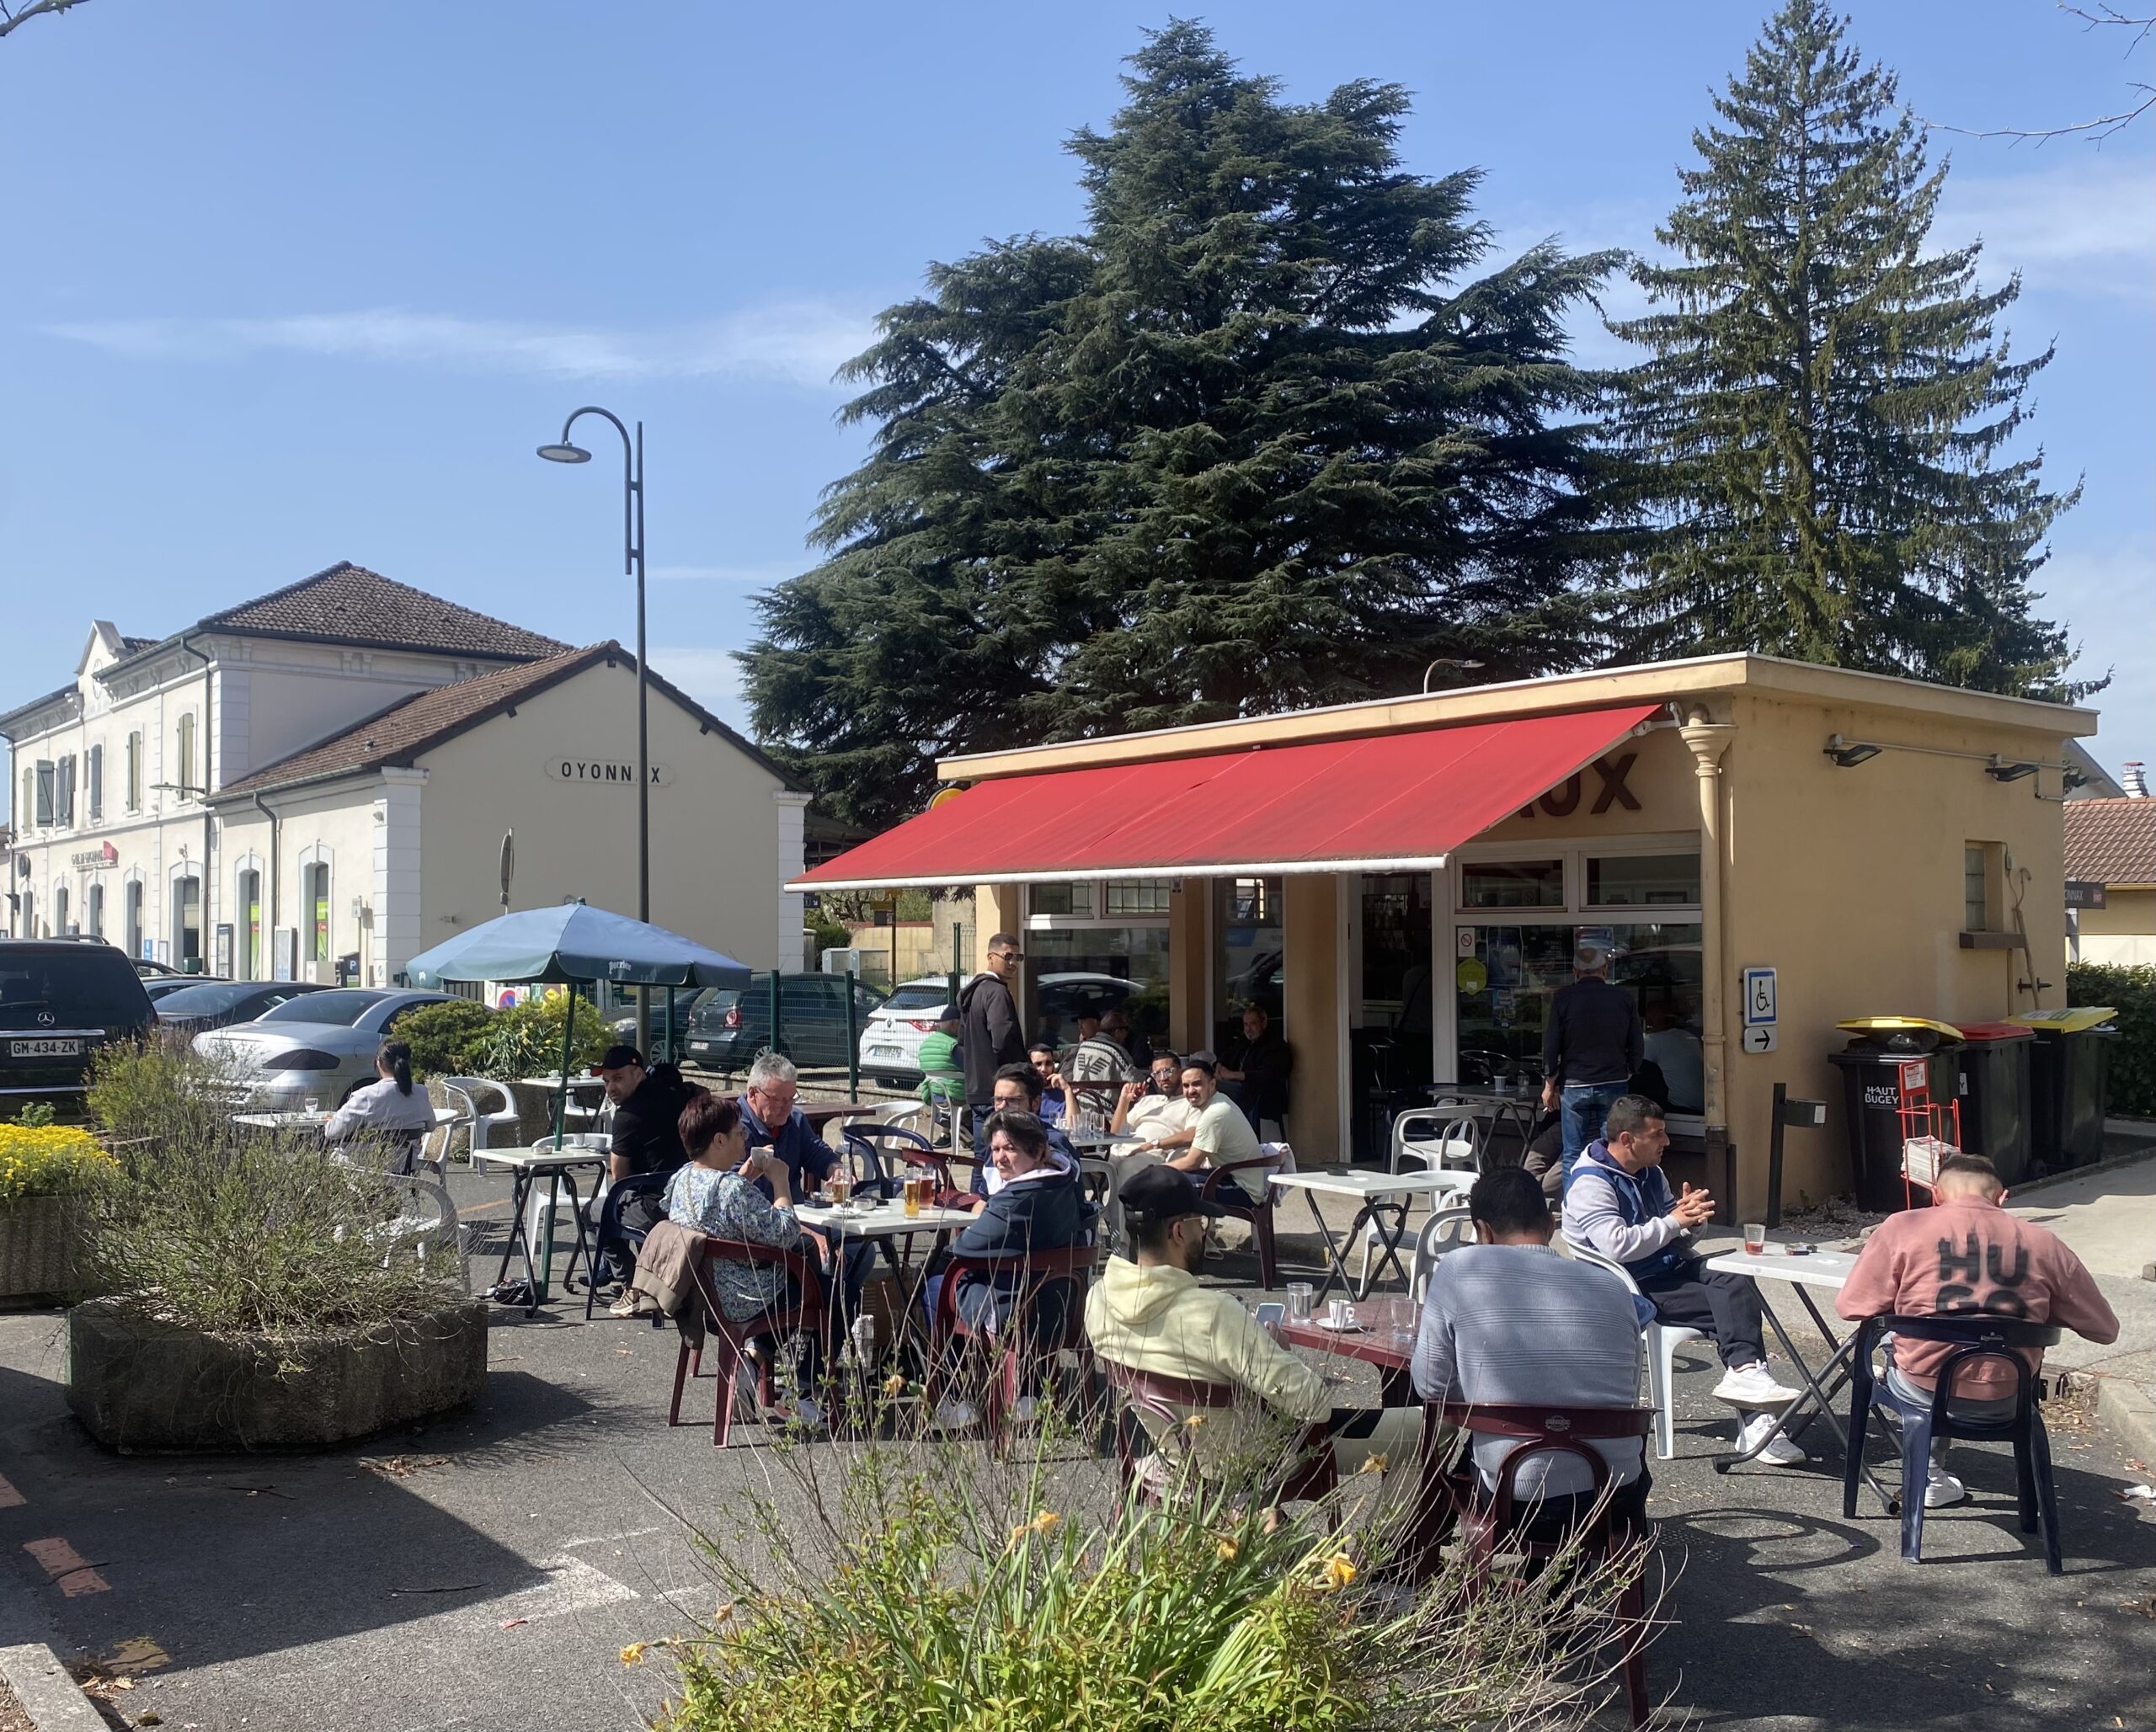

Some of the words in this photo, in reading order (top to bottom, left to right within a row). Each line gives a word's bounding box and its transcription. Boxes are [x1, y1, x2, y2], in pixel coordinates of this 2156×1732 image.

[561, 761, 660, 783] OYONNX
[1520, 753, 1642, 818] UX
[13, 1041, 77, 1054] GM-434-ZK
[1866, 1085, 1897, 1095] HAUT
[1865, 1093, 1899, 1105] BUGEY
[1938, 1233, 2029, 1287] HU
